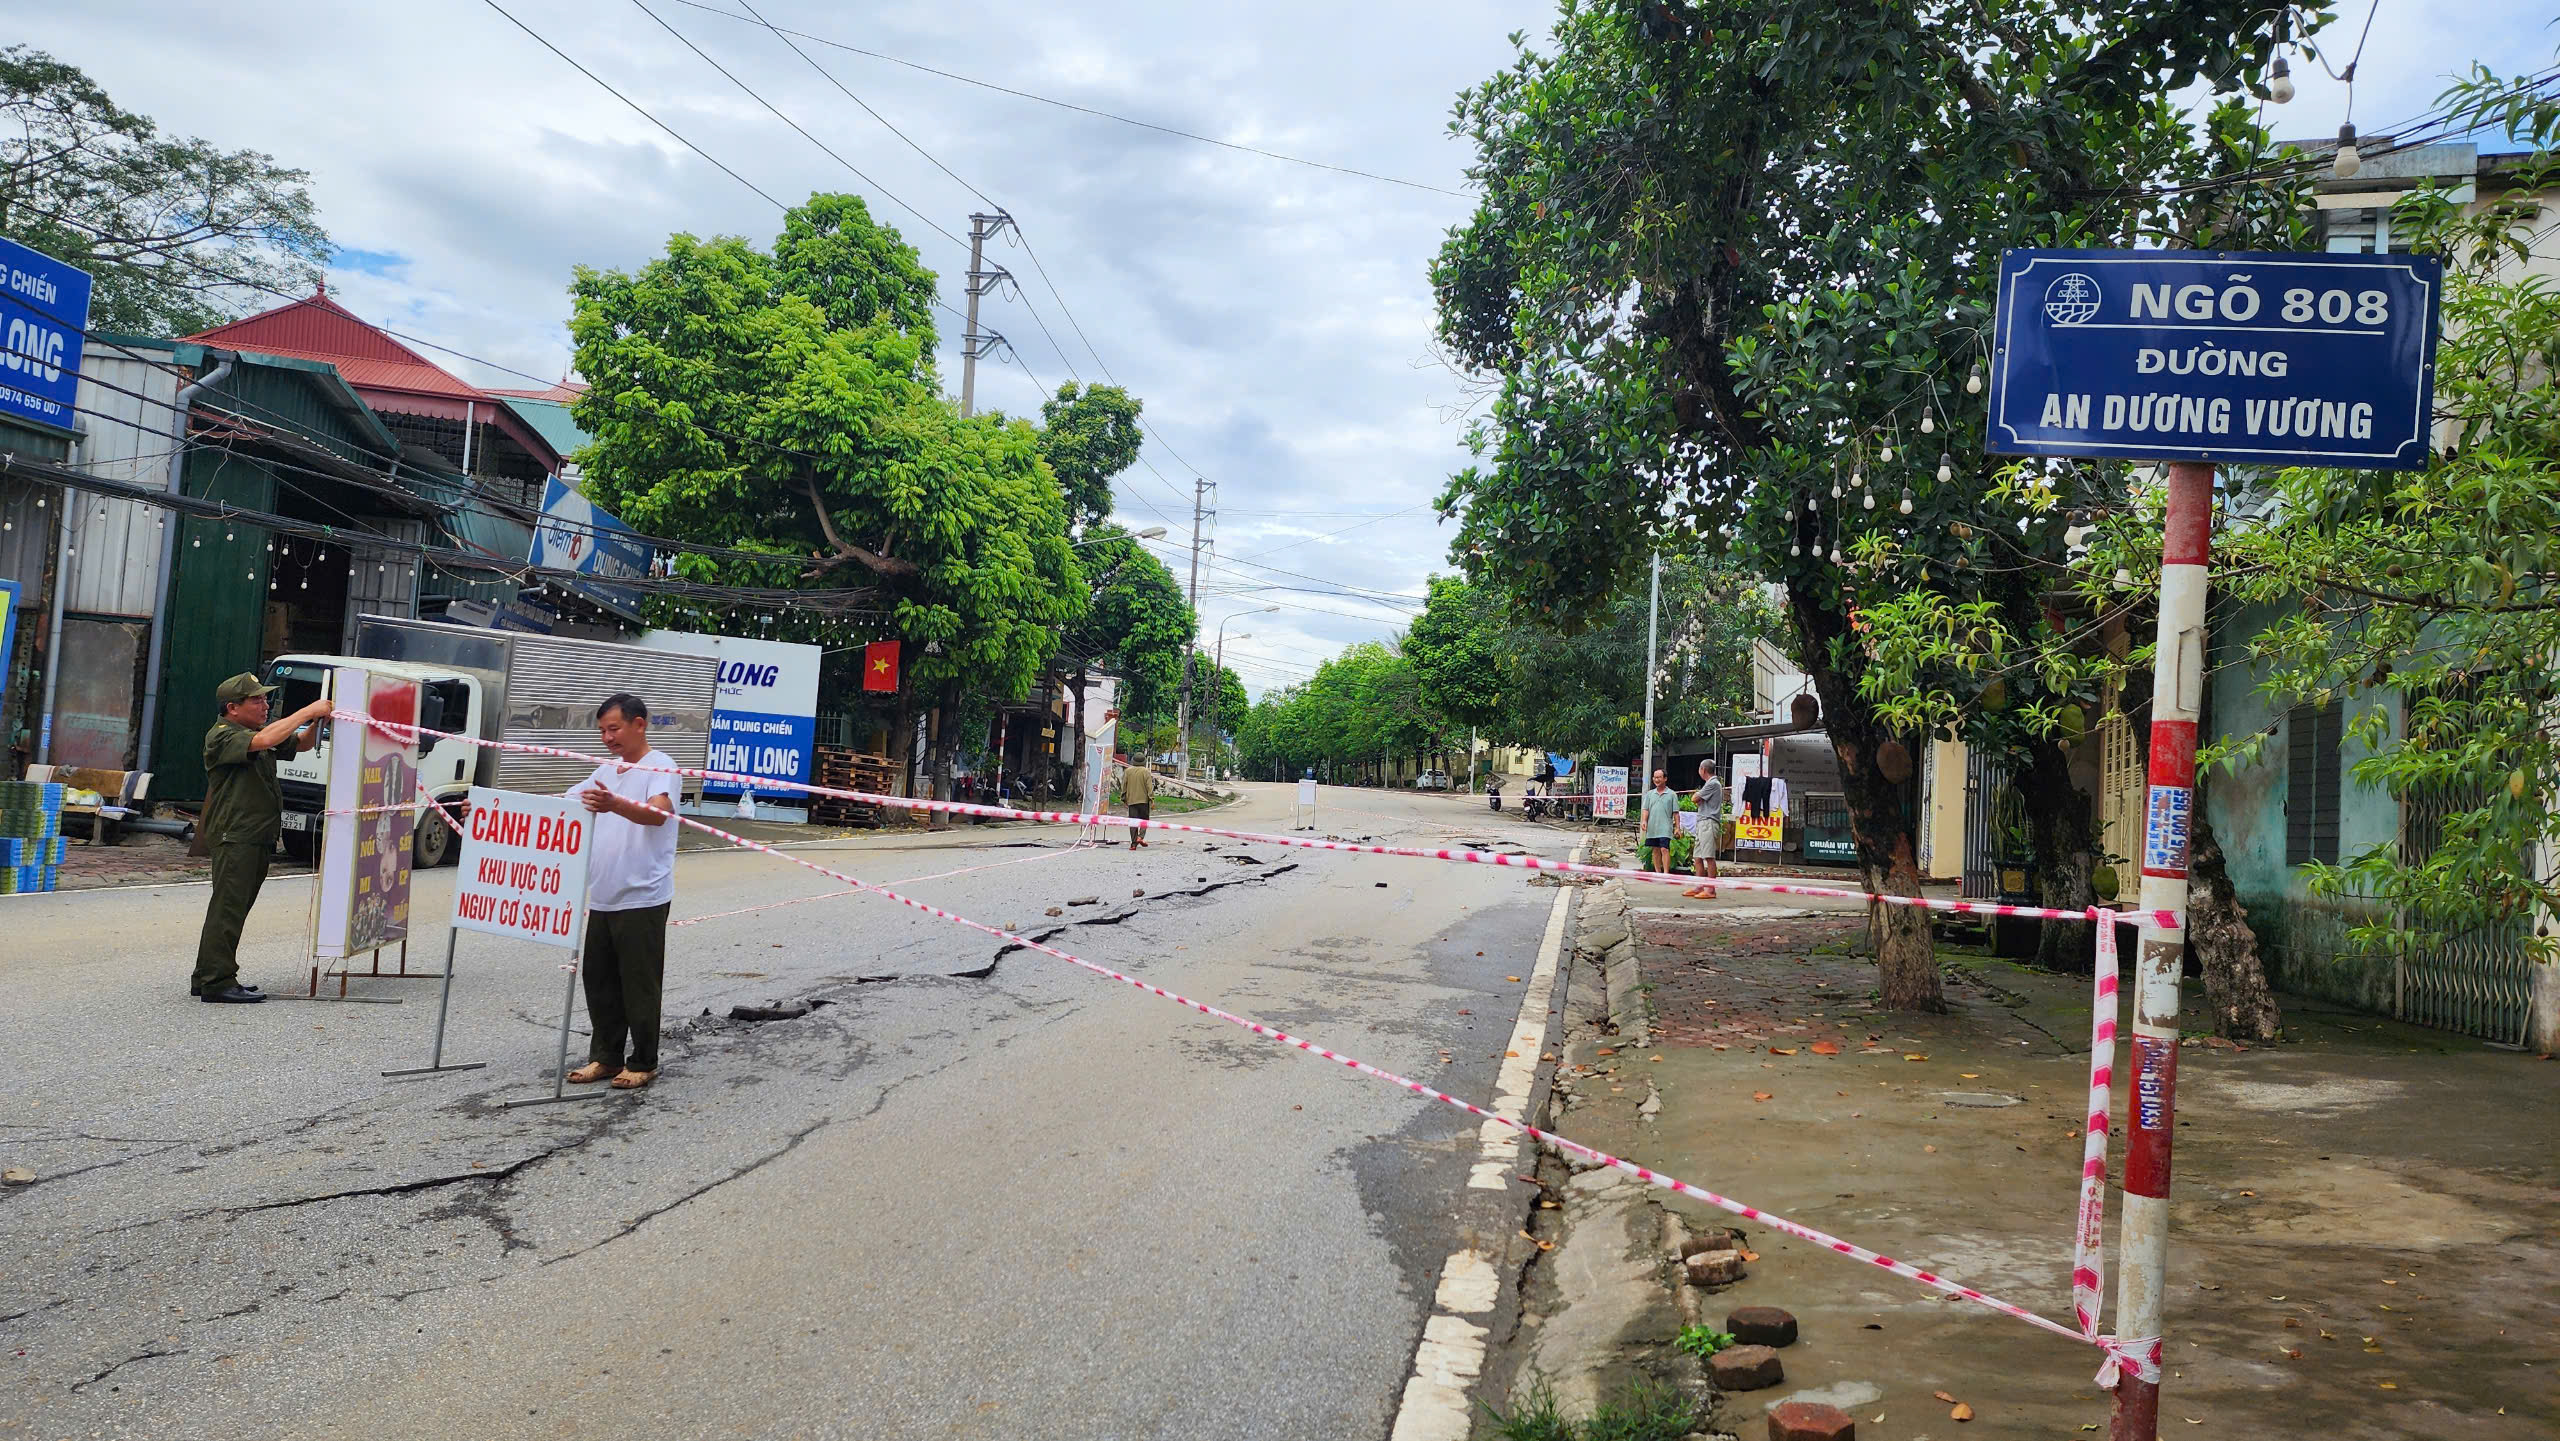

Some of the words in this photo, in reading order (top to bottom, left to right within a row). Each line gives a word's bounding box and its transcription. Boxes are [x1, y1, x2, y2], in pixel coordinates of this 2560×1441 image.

[11, 269, 57, 305] CHIẾN
[2129, 273, 2261, 322] NGÕ
[2281, 289, 2389, 325] 808
[2135, 340, 2288, 378] ĐƯỜNG
[24, 395, 42, 411] 656
[43, 401, 61, 416] 007
[2039, 393, 2091, 429] AN
[2102, 392, 2231, 434] DƯƠNG
[2245, 395, 2374, 439] VƯƠNG
[717, 660, 779, 687] LONG
[733, 719, 761, 733] DUNG
[763, 719, 792, 735] CHIẾN
[284, 768, 318, 779] ISUZU
[364, 768, 382, 784] NAIL
[753, 746, 799, 776] LONG
[285, 812, 299, 822] 28C
[1595, 796, 1608, 815] XE
[472, 798, 531, 848] CẢNH
[536, 811, 582, 855] BÁO
[477, 857, 506, 886] KHU
[510, 861, 538, 895] VỰC
[540, 863, 561, 895] CÓ
[458, 893, 497, 922] NGUY
[499, 899, 521, 927] CƠ
[521, 903, 550, 937] SẠT
[552, 901, 573, 936] LỞ
